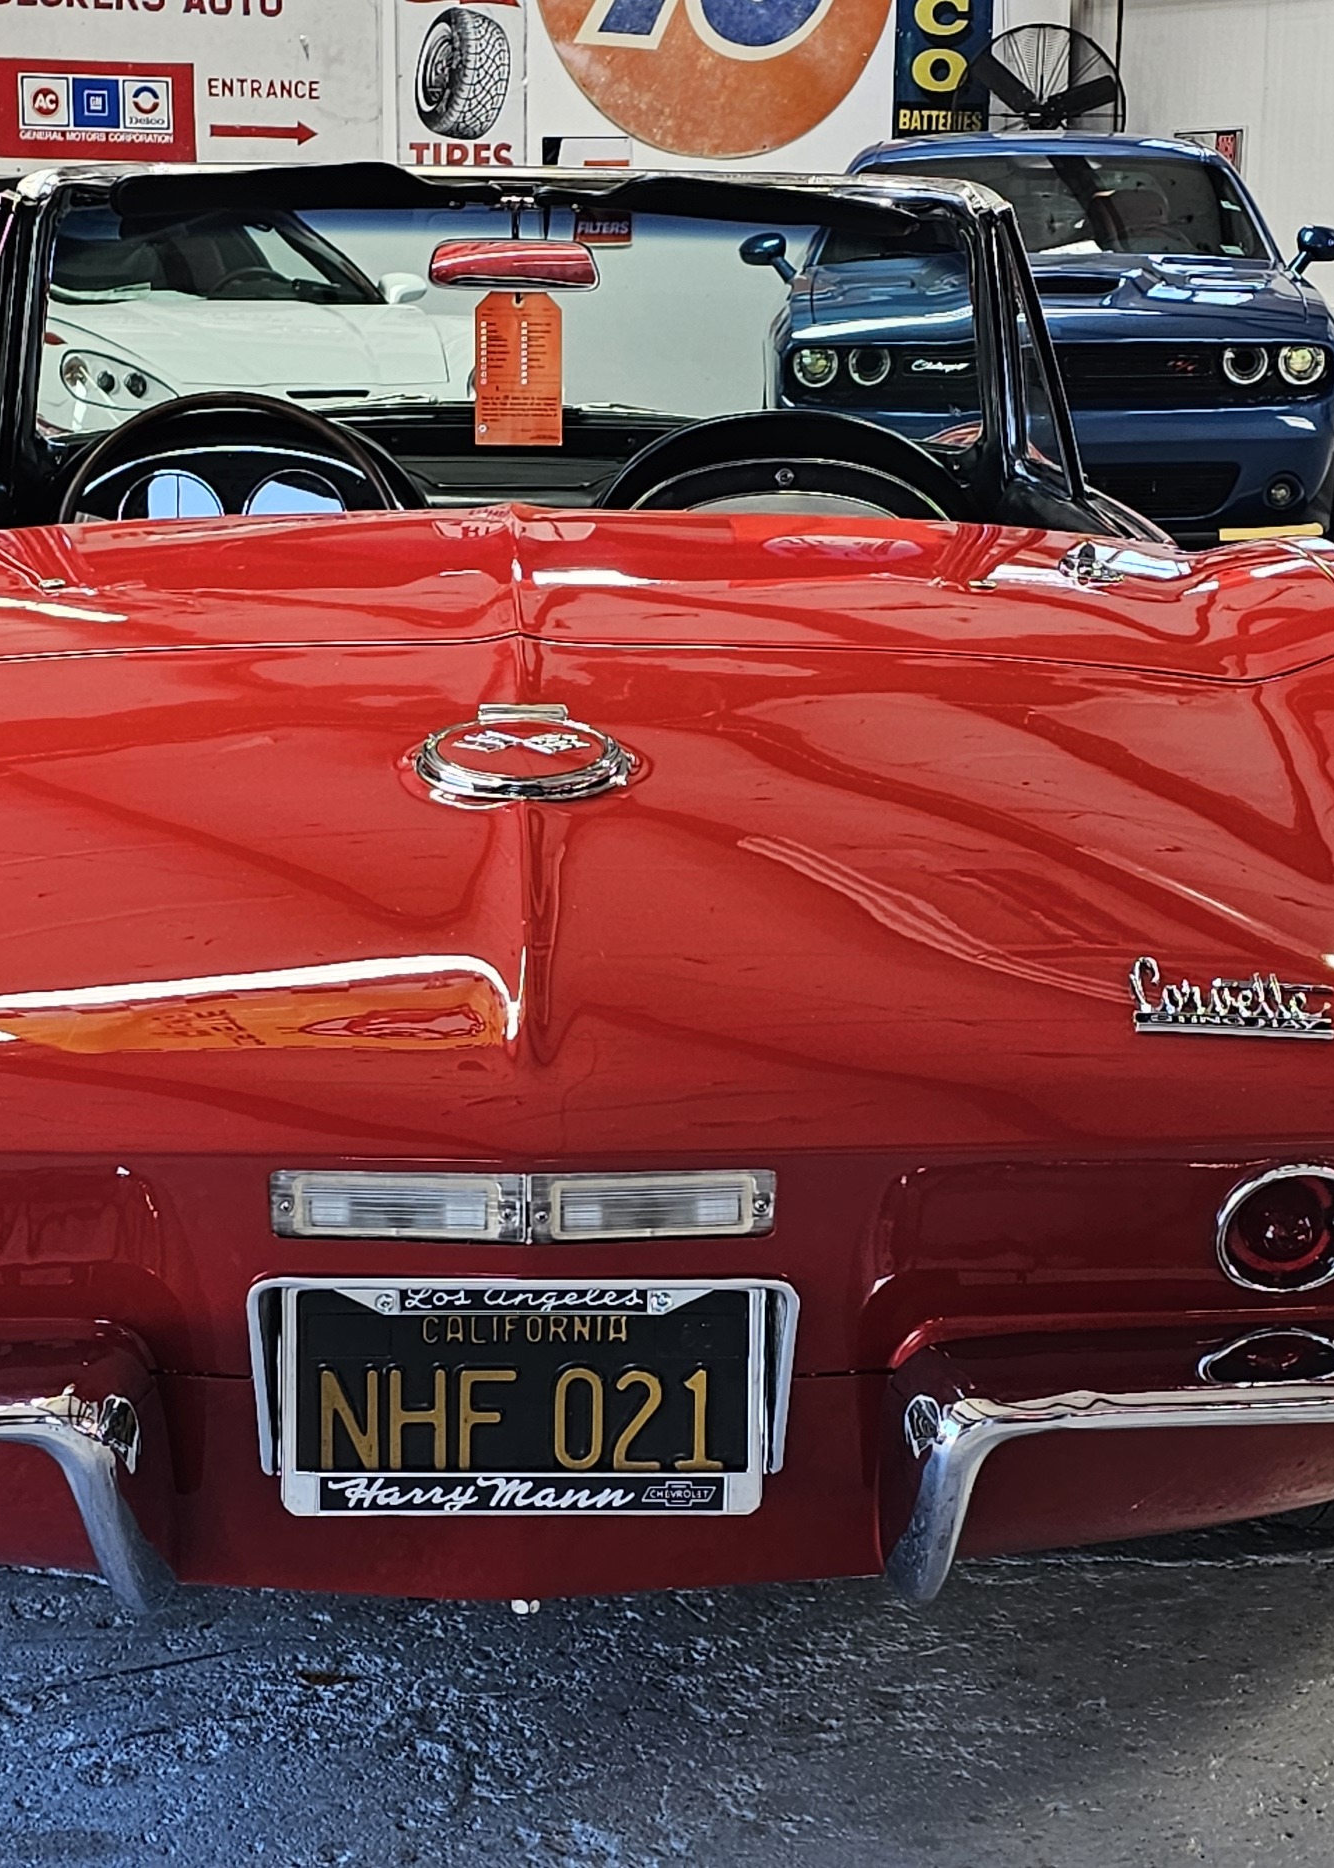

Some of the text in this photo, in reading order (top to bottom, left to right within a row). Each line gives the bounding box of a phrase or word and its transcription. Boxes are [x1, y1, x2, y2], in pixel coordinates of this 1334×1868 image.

[207, 78, 320, 100] ENTRANCE
[34, 93, 57, 109] AC
[129, 116, 165, 125] Delco
[899, 109, 982, 131] BATTERIES
[19, 130, 173, 143] GENERAL MOTORS CORPORATION
[577, 221, 629, 234] FILTERS
[1129, 956, 1334, 1018] Corvette
[404, 1288, 644, 1313] Los Angeles
[422, 1315, 627, 1344] CALIFORNIA
[319, 1366, 724, 1471] NHF 021
[327, 1476, 479, 1511] Harry
[476, 1476, 635, 1510] Mann
